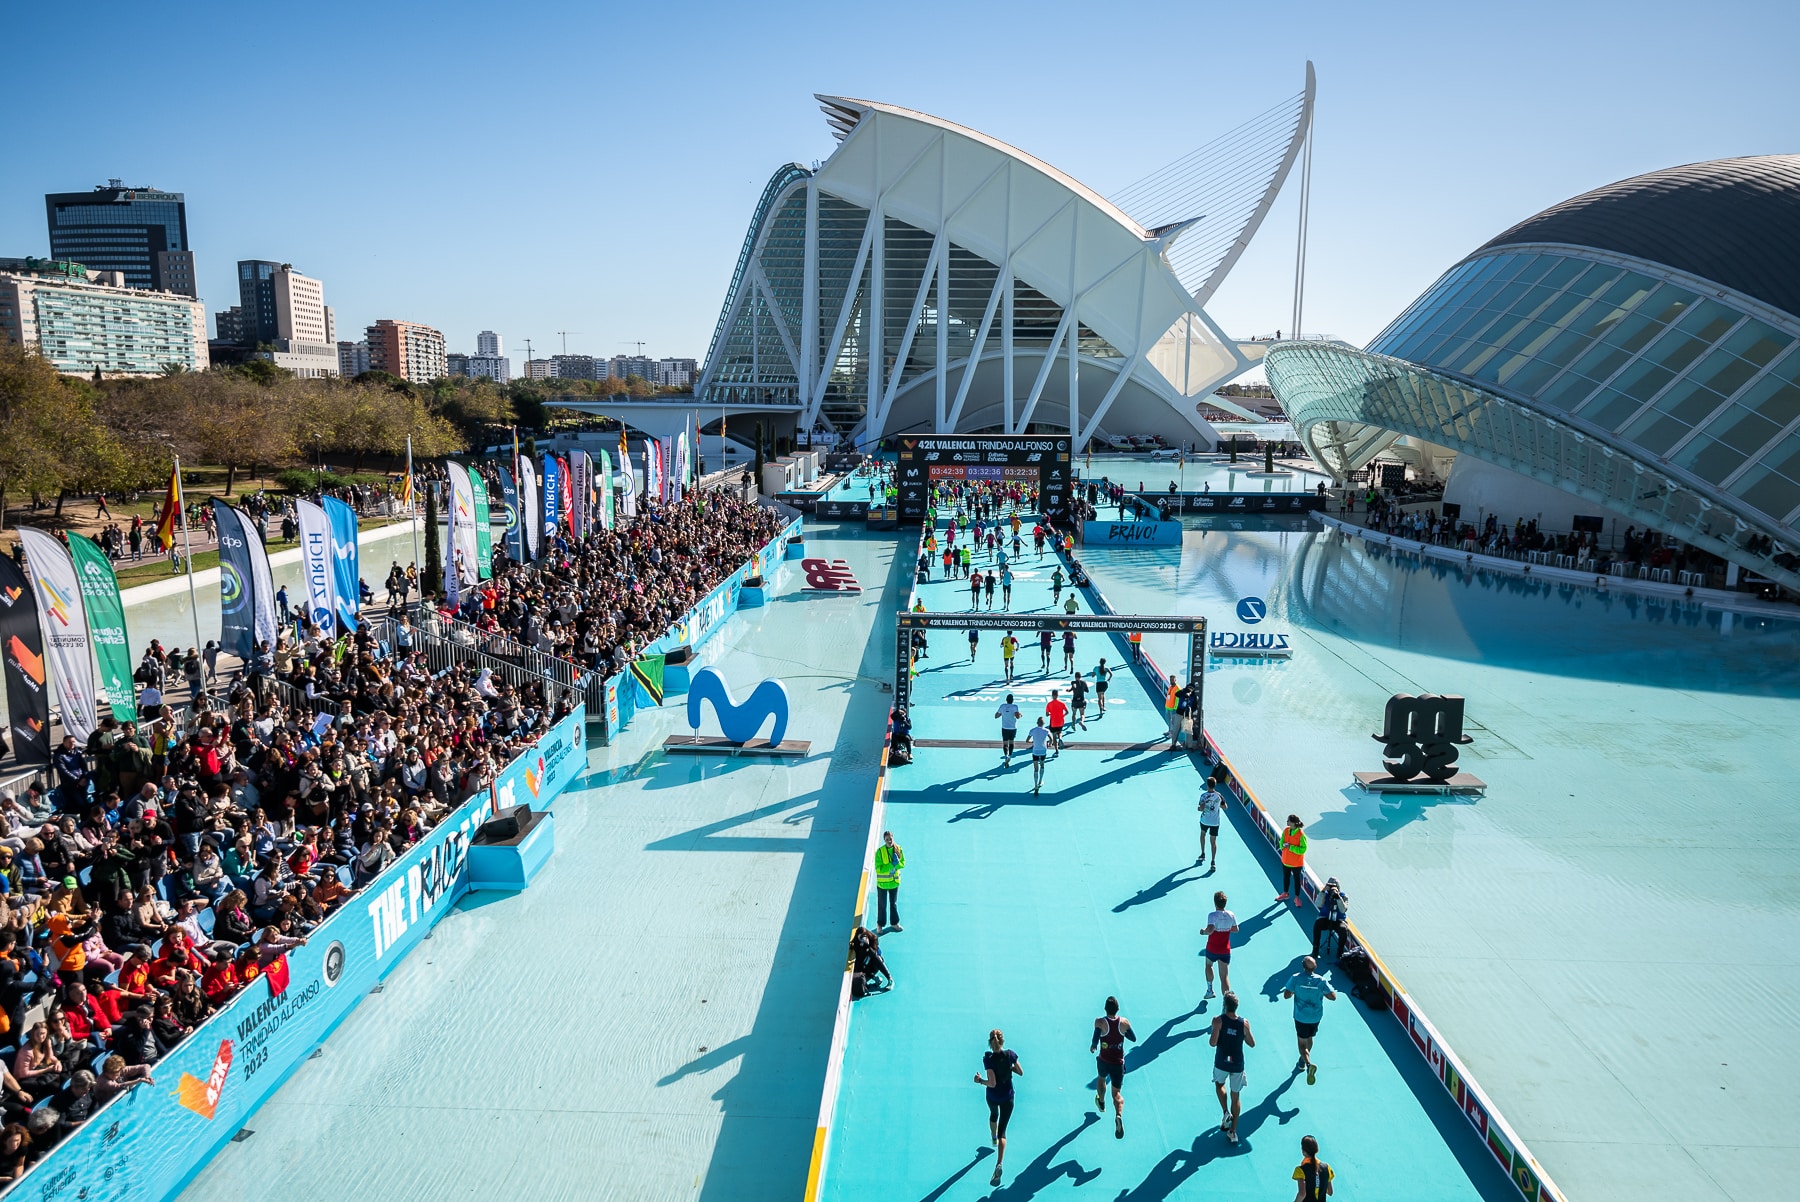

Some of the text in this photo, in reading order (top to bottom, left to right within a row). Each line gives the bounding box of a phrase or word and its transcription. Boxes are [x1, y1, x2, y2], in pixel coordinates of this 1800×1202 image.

[918, 440, 1053, 450] 42K VALENCIA TRINIDAD ALFONSO
[1109, 524, 1157, 542] BRAVO!
[368, 878, 407, 960] THE
[237, 988, 288, 1042] VALENCIA
[240, 980, 320, 1063] TRINIDAD ALFONSO
[206, 1056, 229, 1106] 42K
[244, 1046, 268, 1082] 2023
[42, 1166, 68, 1195] Cultura
[44, 1171, 76, 1202] Esfuerzo
